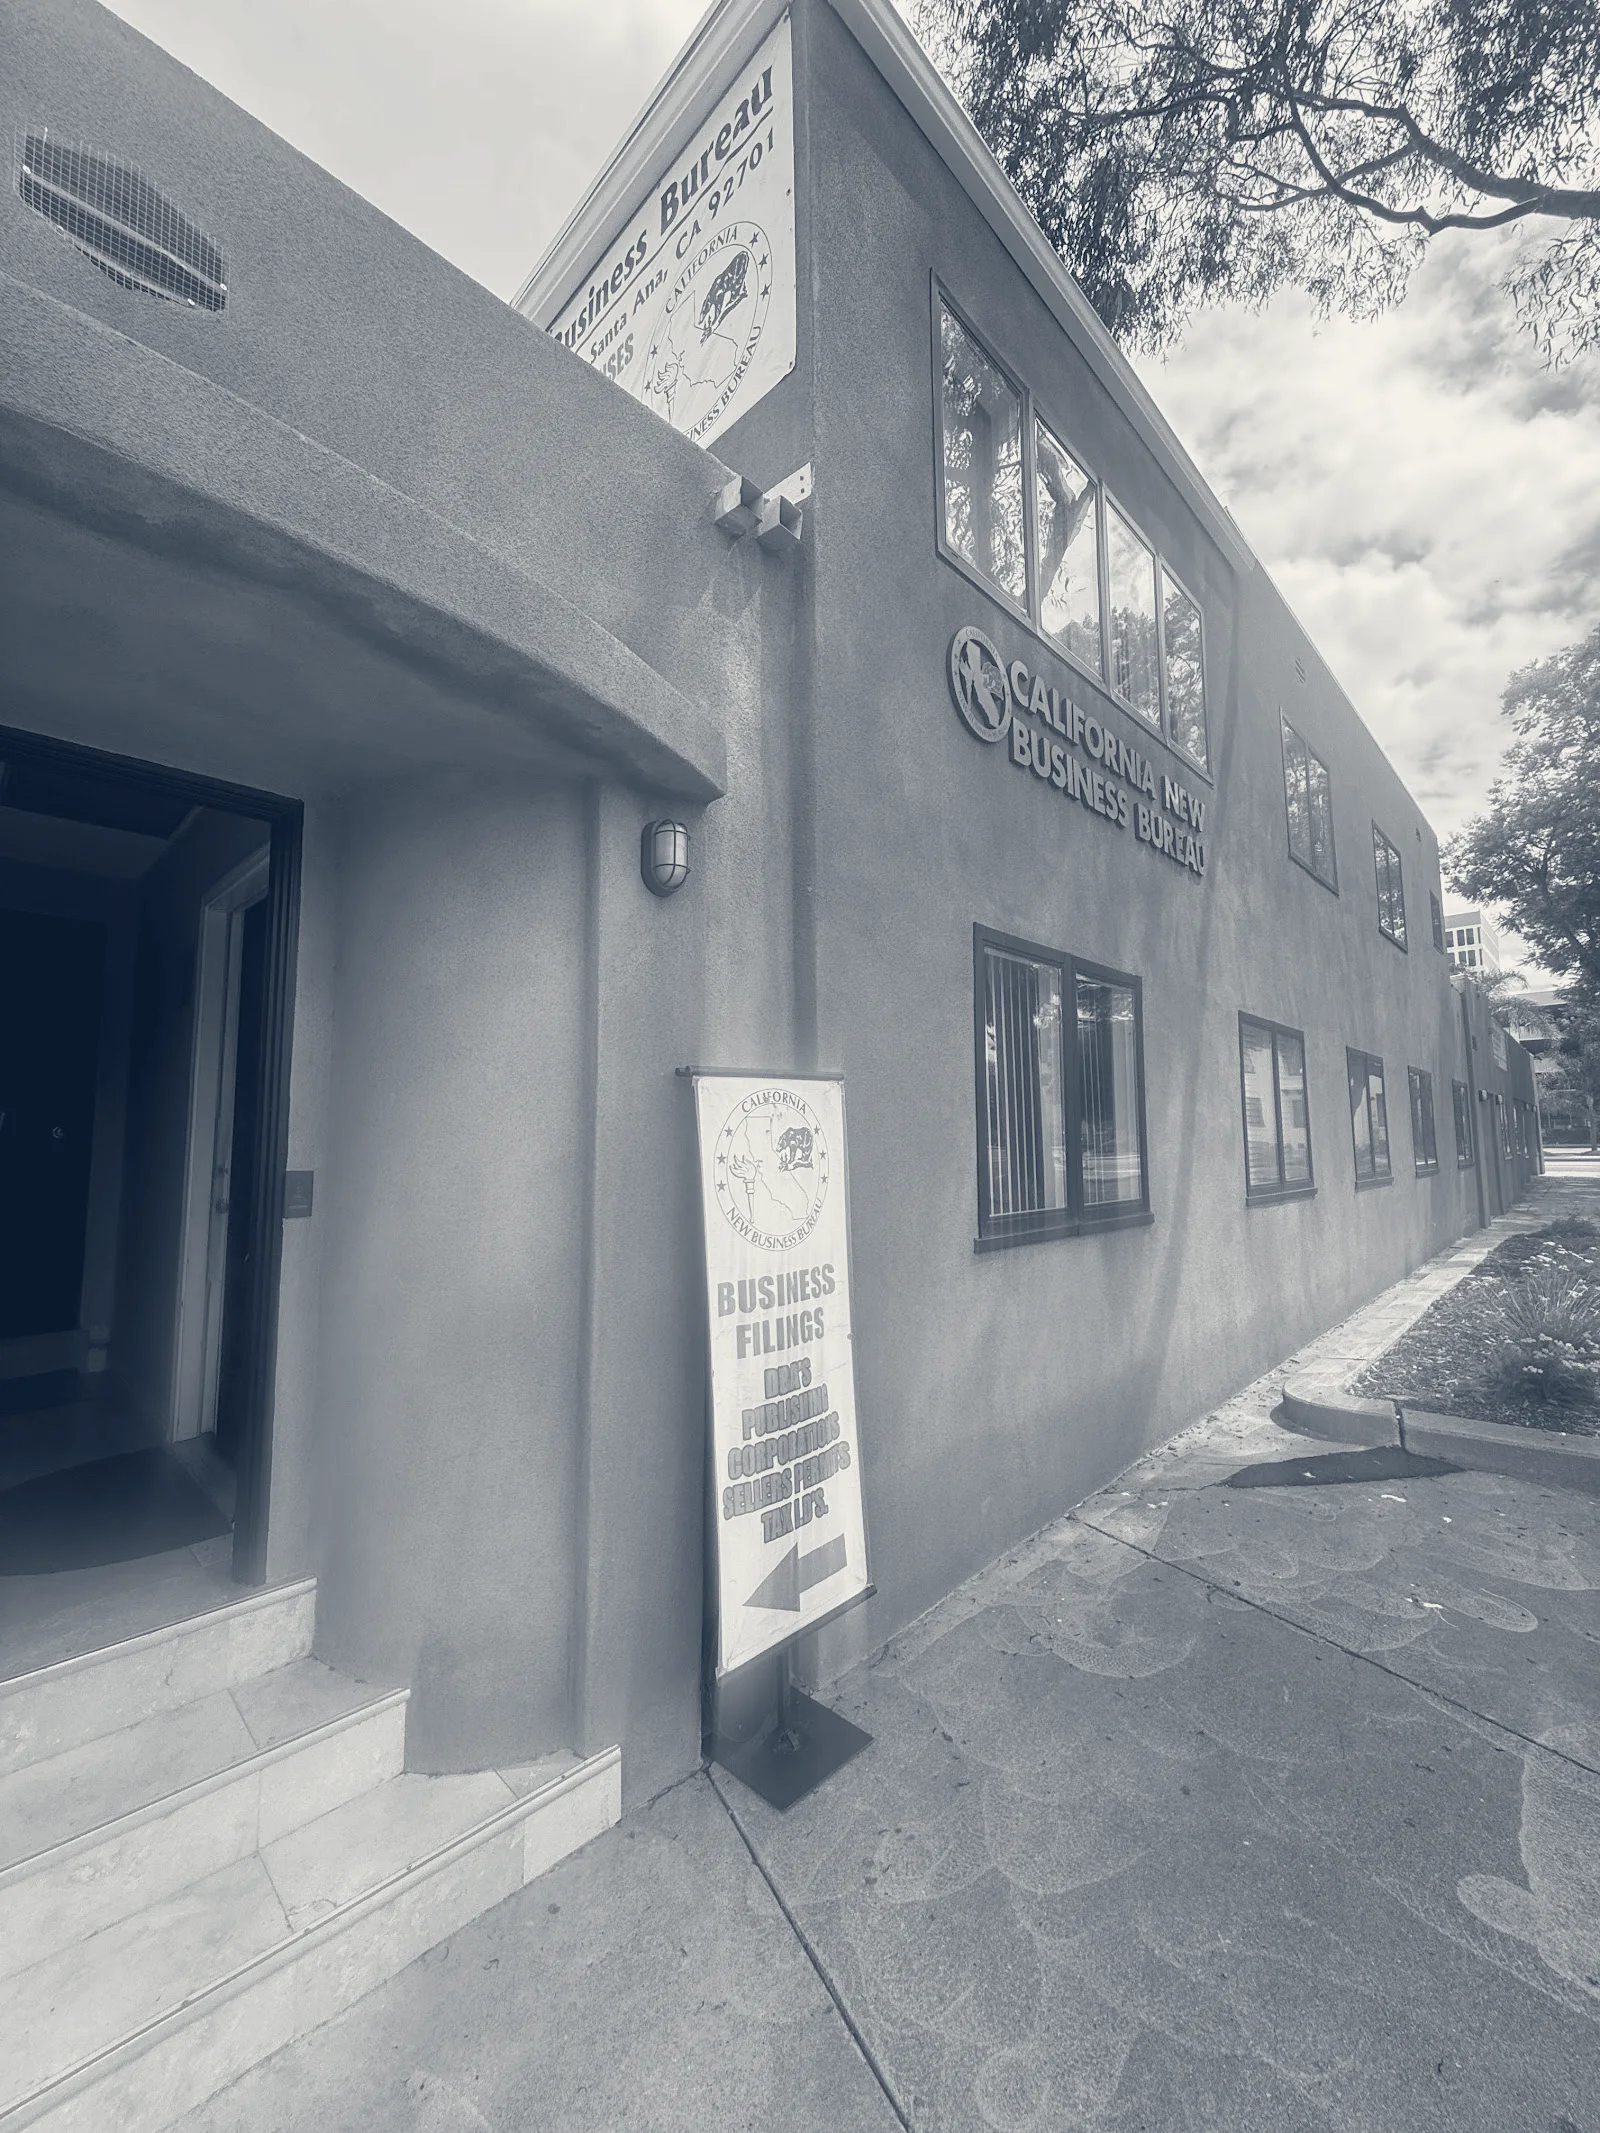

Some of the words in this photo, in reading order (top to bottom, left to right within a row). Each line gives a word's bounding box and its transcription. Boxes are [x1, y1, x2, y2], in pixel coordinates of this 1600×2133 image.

[550, 229, 647, 349] usiness
[660, 66, 773, 236] Bureau
[590, 312, 627, 364] Santa
[632, 269, 668, 316] Ana,
[675, 219, 702, 260] CA
[708, 126, 774, 221] 92701
[665, 225, 738, 315] CALIFORNIA
[721, 326, 761, 407] BUREAU
[1009, 660, 1157, 800] CALIFORNIA
[1161, 775, 1206, 832] NEW
[1010, 717, 1129, 828] BUSINESS
[1134, 803, 1206, 876] BUREAU
[741, 1091, 806, 1115] CALIFORNIA
[726, 1207, 752, 1236] NEW
[751, 1231, 797, 1249] BUSINESS
[797, 1197, 823, 1240] BUREAU
[717, 1263, 836, 1317] BUSINESS
[735, 1306, 825, 1360] FILINGS
[764, 1356, 812, 1400] DBA'S
[723, 1467, 793, 1520] SELLERS
[794, 1441, 851, 1494] PERMITS
[727, 1411, 840, 1481] CORPORATIONS
[761, 1502, 794, 1543] TAX
